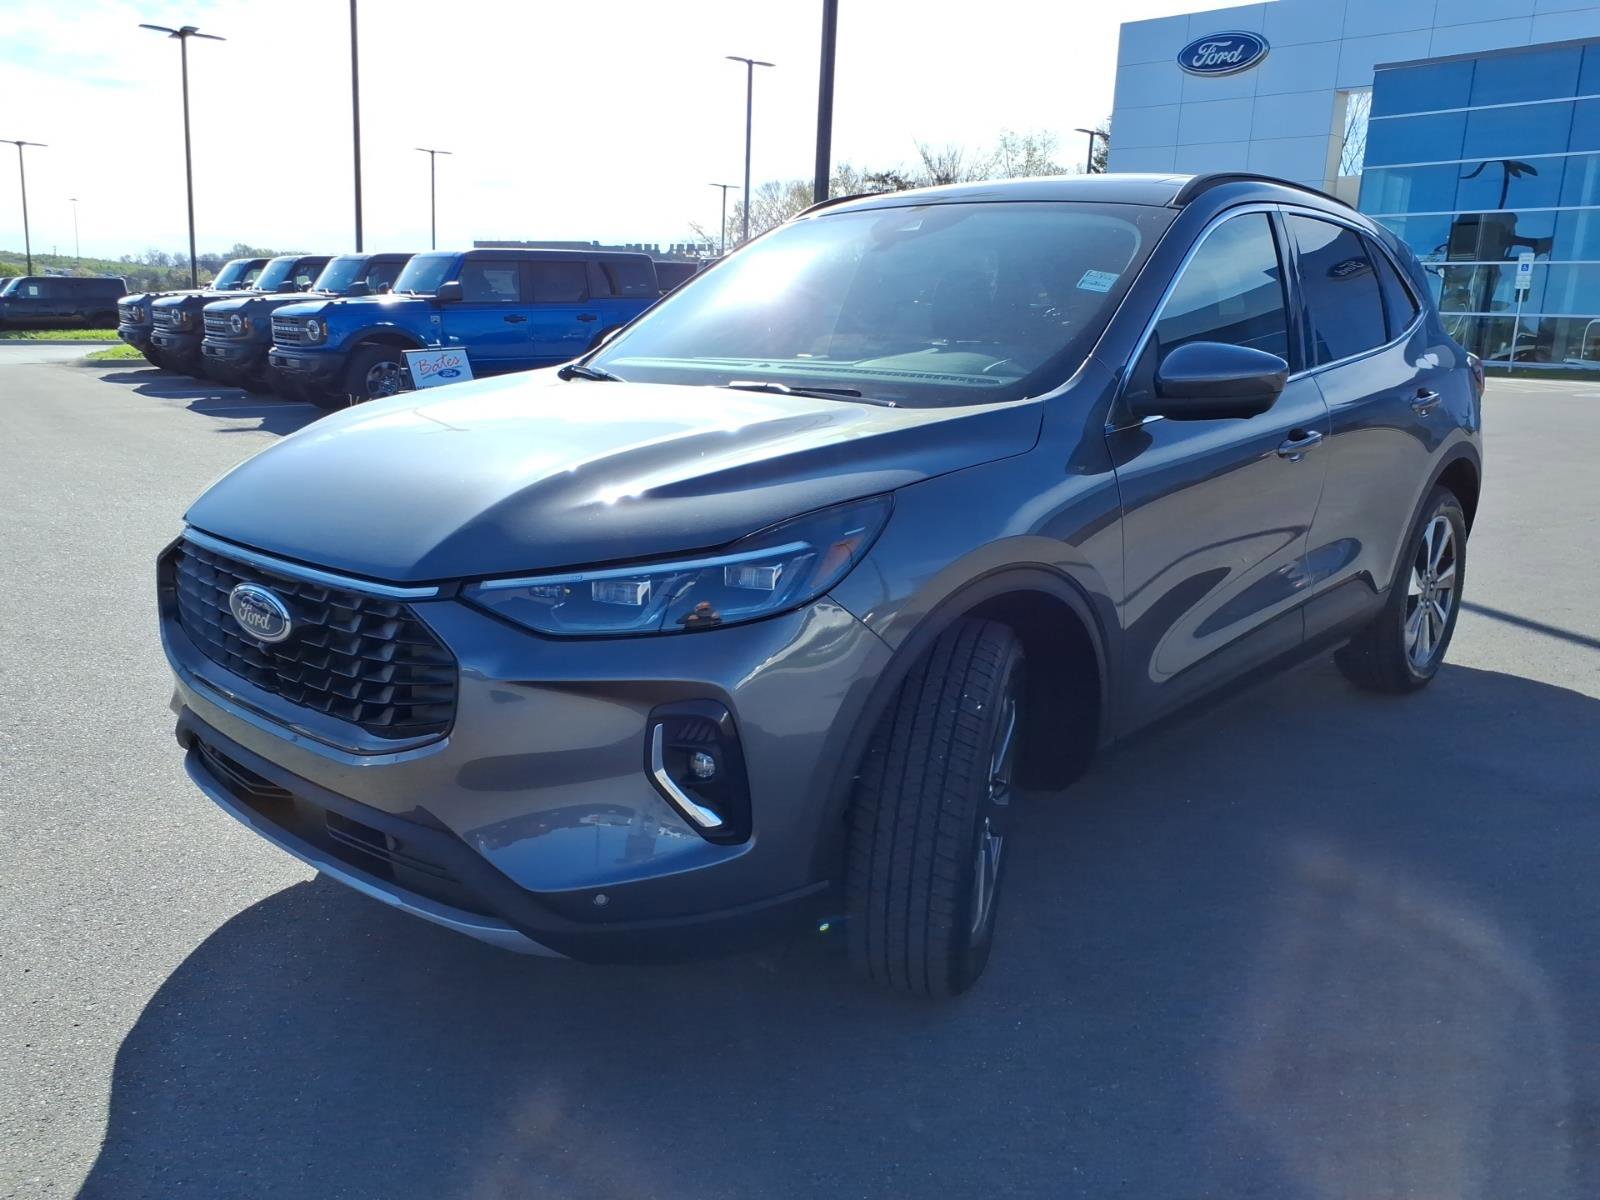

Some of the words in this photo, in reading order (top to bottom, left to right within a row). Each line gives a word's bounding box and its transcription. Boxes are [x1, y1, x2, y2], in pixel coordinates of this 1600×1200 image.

[1192, 41, 1245, 67] Ford
[416, 354, 461, 376] Bates
[239, 596, 272, 630] Ford
